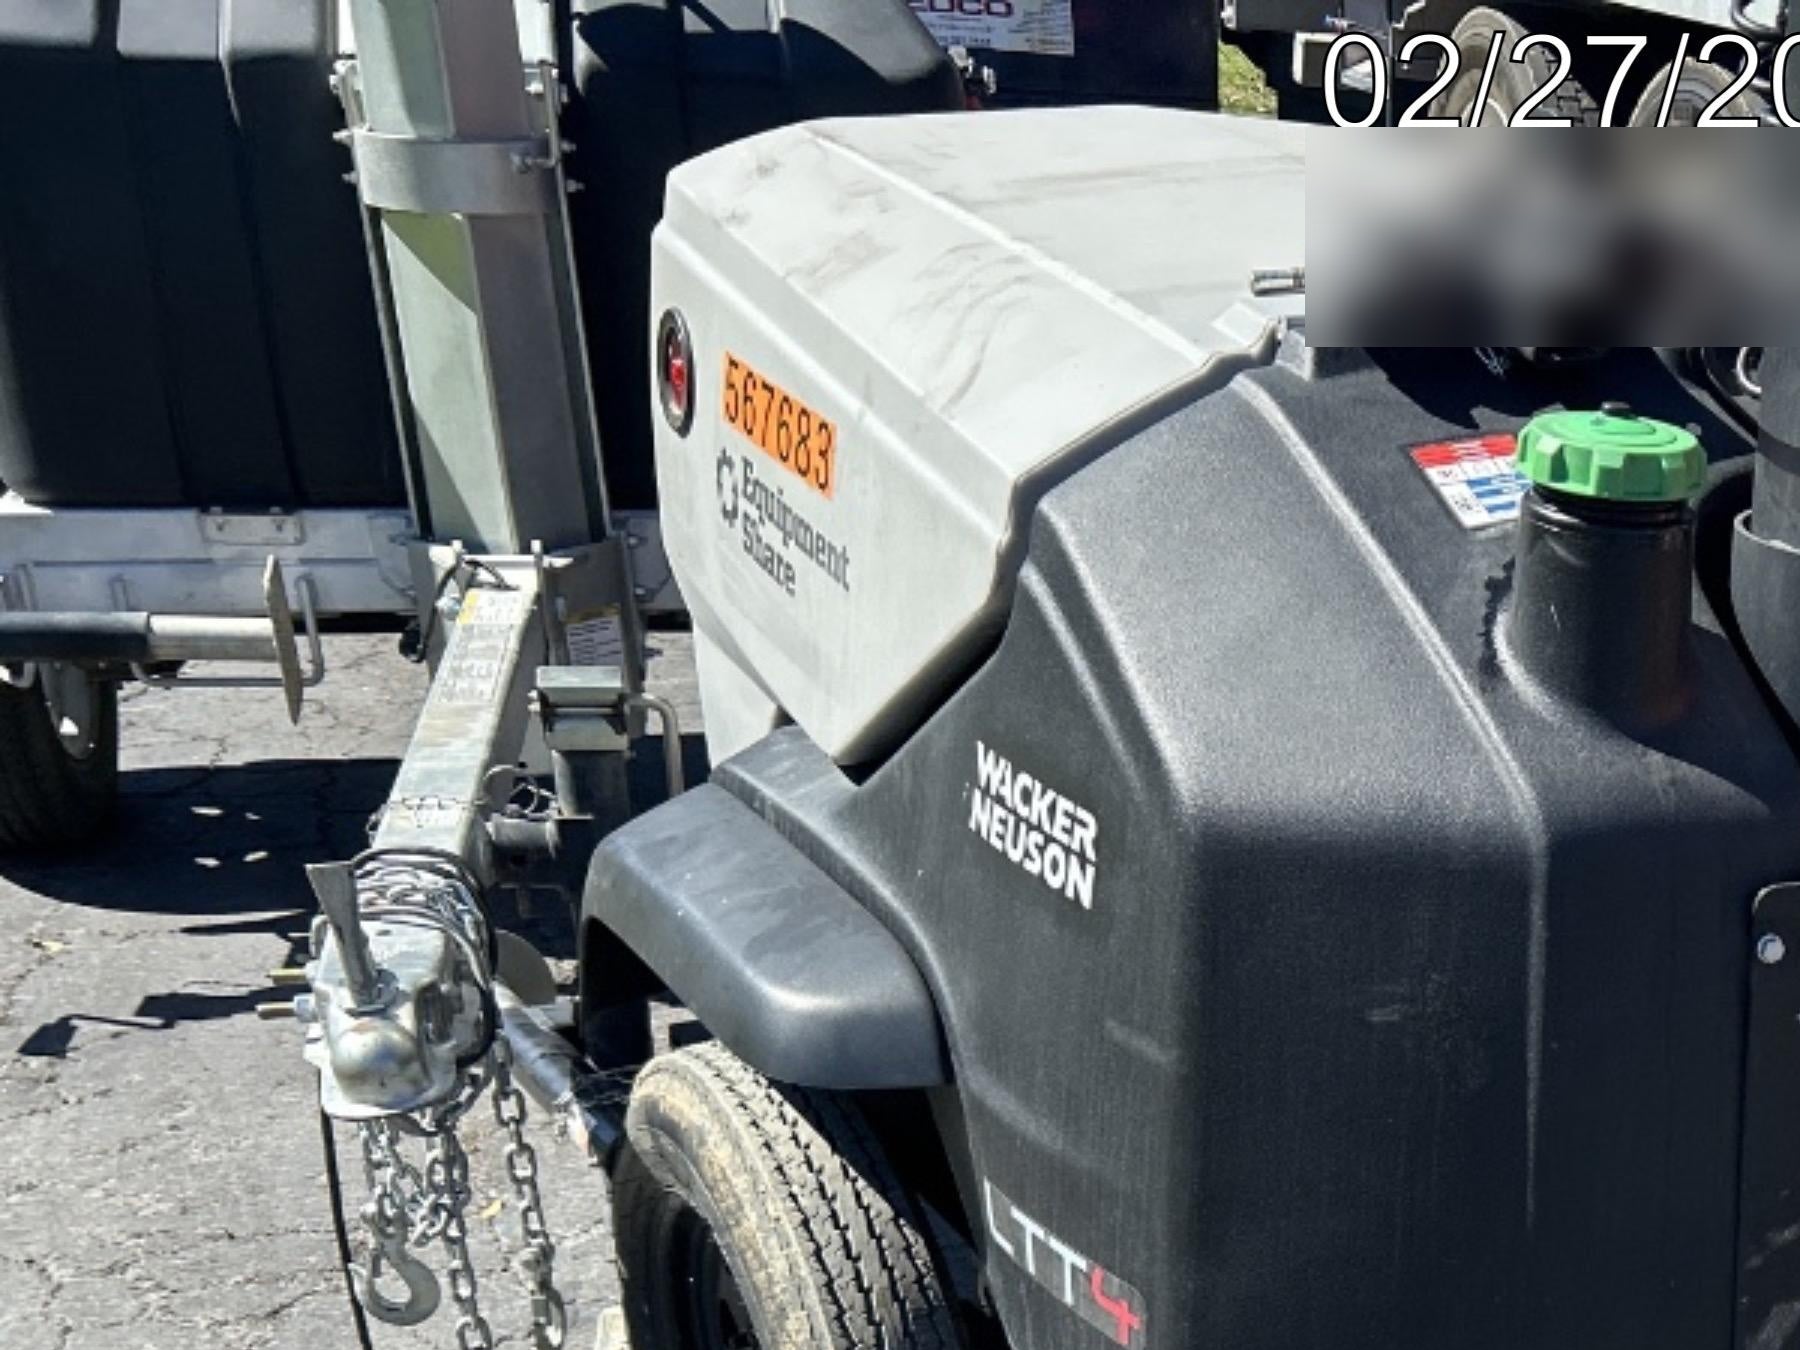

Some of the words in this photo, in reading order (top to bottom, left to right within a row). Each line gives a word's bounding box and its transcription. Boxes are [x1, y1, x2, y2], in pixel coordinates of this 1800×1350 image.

[724, 355, 832, 493] 567683
[741, 455, 850, 594] Equipment
[742, 511, 796, 597] Share
[968, 787, 1096, 910] NEUSON
[975, 739, 1097, 863] WACKER
[983, 1174, 1141, 1347] LTT4
